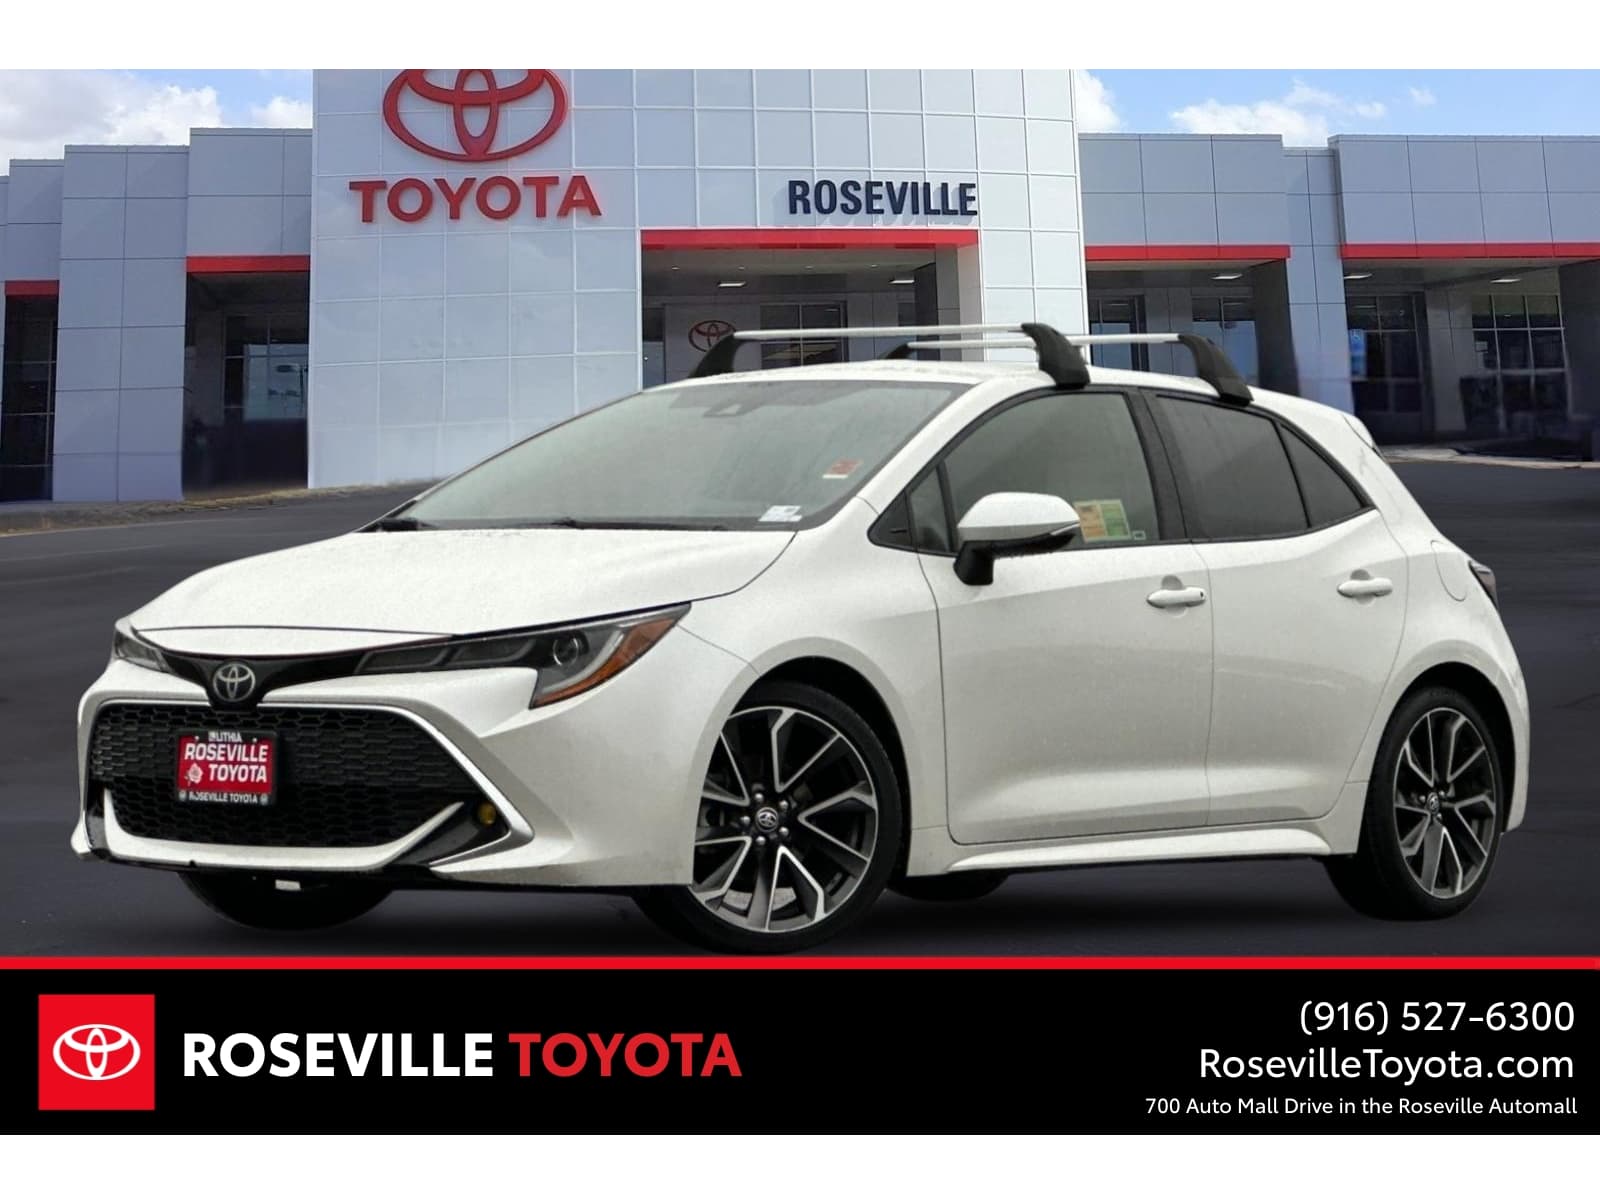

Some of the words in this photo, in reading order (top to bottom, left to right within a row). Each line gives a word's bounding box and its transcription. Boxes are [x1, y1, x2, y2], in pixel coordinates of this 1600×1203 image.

[349, 175, 602, 223] TOYOTA
[788, 180, 978, 216] ROSEVILLE
[216, 731, 243, 743] LITHIA
[184, 743, 269, 762] ROSEVILLE
[208, 764, 267, 783] TOYOTA
[188, 791, 228, 802] ROSEVILLE
[230, 793, 258, 804] TOYOTA
